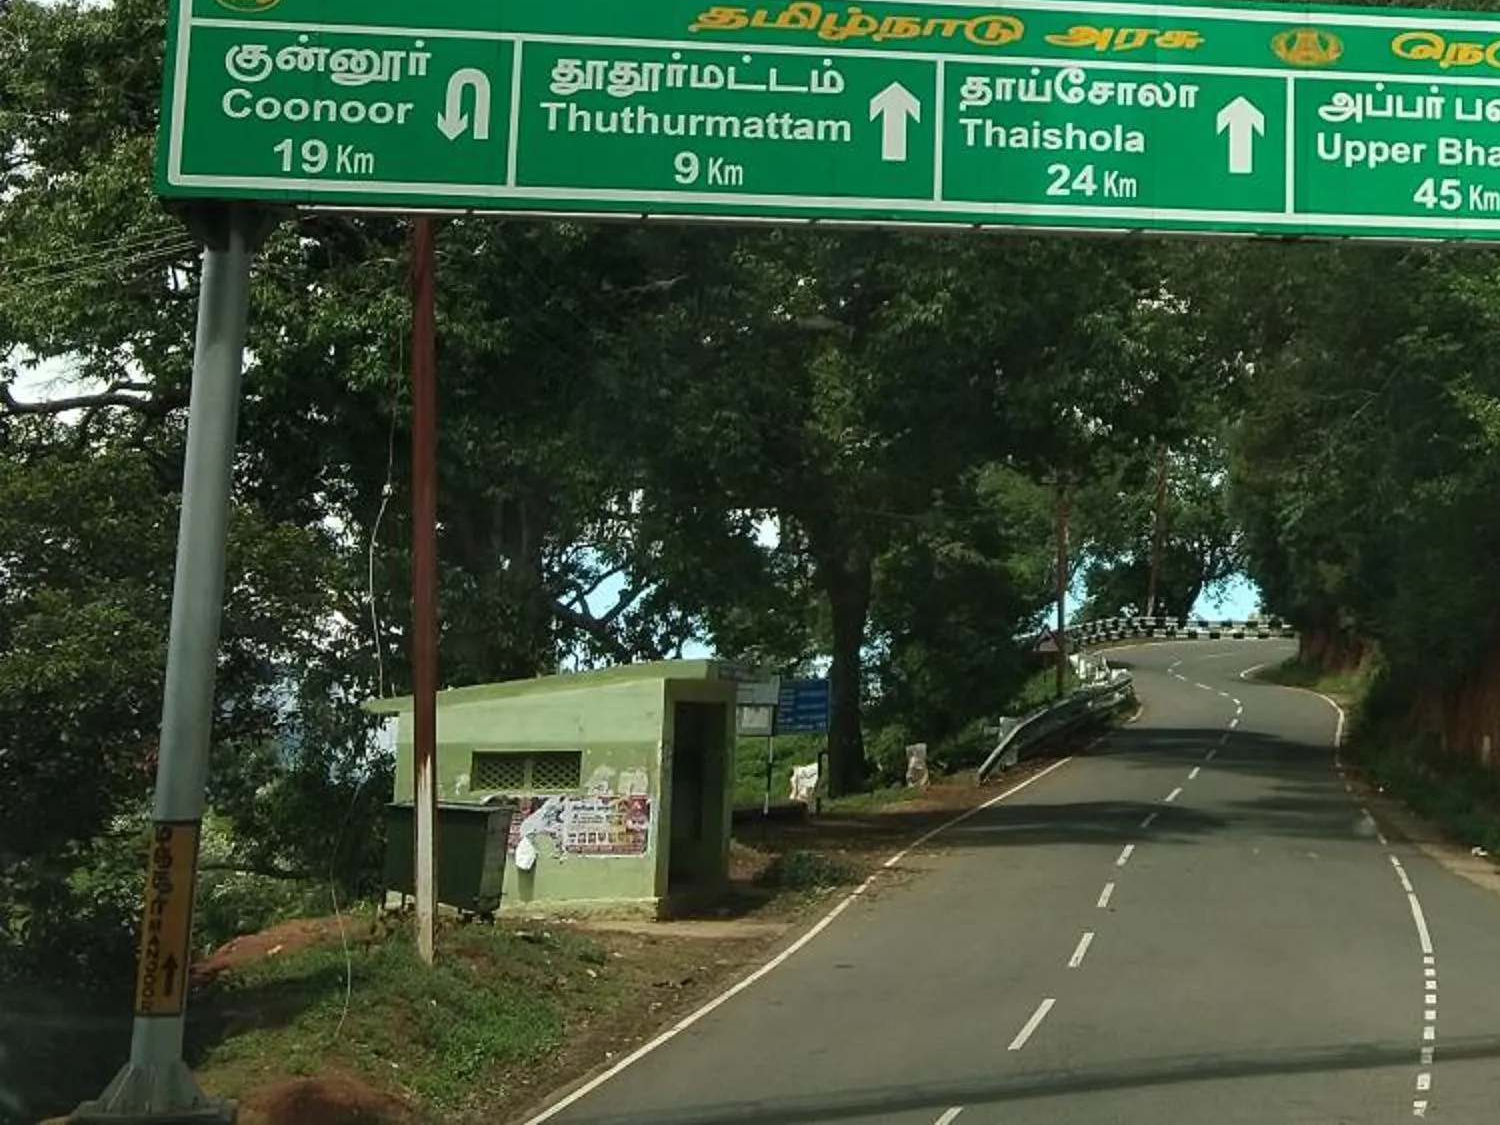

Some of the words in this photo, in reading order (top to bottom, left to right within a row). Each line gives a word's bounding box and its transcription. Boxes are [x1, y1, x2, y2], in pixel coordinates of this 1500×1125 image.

[687, 0, 1026, 46] தமிழ்நாடு
[1044, 25, 1206, 52] அரசு
[225, 33, 432, 86] குன்னூர்
[550, 50, 845, 97] தூதூர்மட்டம்
[221, 86, 414, 125] Coonoor
[958, 66, 1200, 112] தாய்சோலா
[1317, 81, 1446, 124] அப்பர்
[540, 102, 851, 142] Thuthurmattam
[959, 118, 1145, 152] Thaishola
[273, 138, 328, 173] 19
[337, 145, 374, 174] Km
[674, 152, 699, 184] 9
[708, 157, 743, 185] Km
[1317, 132, 1427, 169] Upper
[1046, 163, 1097, 196] 24
[1104, 170, 1137, 198] Km
[1413, 178, 1462, 210] 45
[1469, 185, 1500, 210] Km
